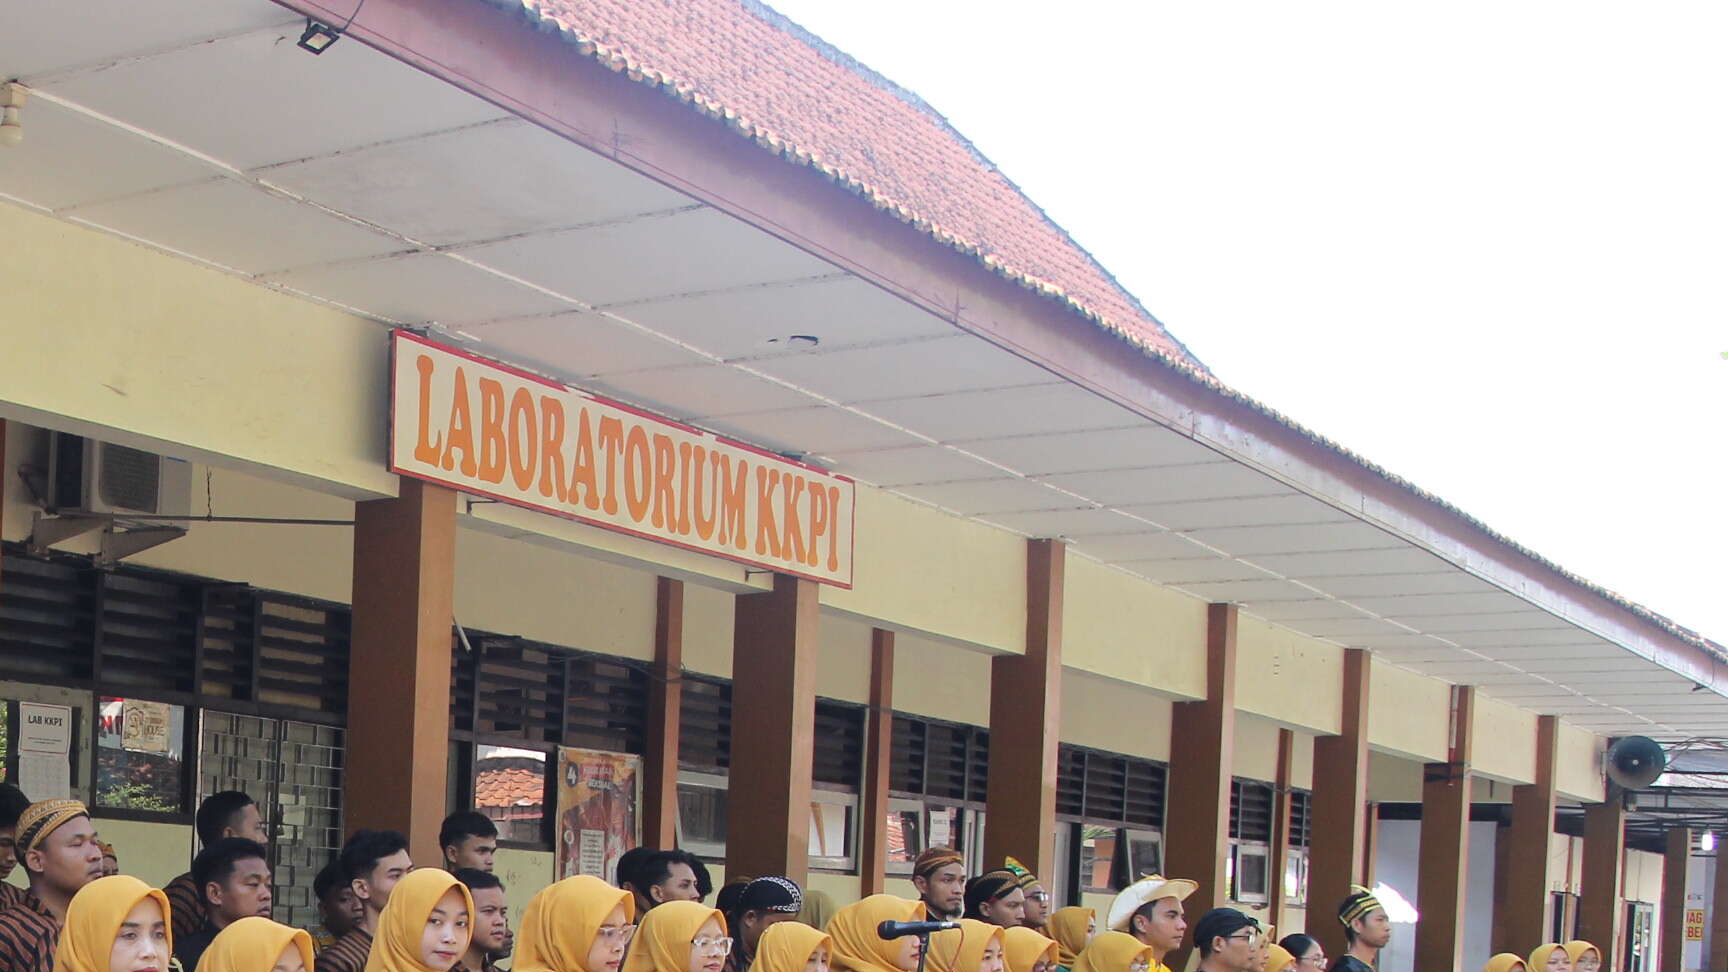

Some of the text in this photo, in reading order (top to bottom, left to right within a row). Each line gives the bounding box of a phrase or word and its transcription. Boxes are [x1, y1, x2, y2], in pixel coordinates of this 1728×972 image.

[414, 354, 841, 573] LABORATORIUM KKPI
[28, 714, 63, 727] LAB KKPI
